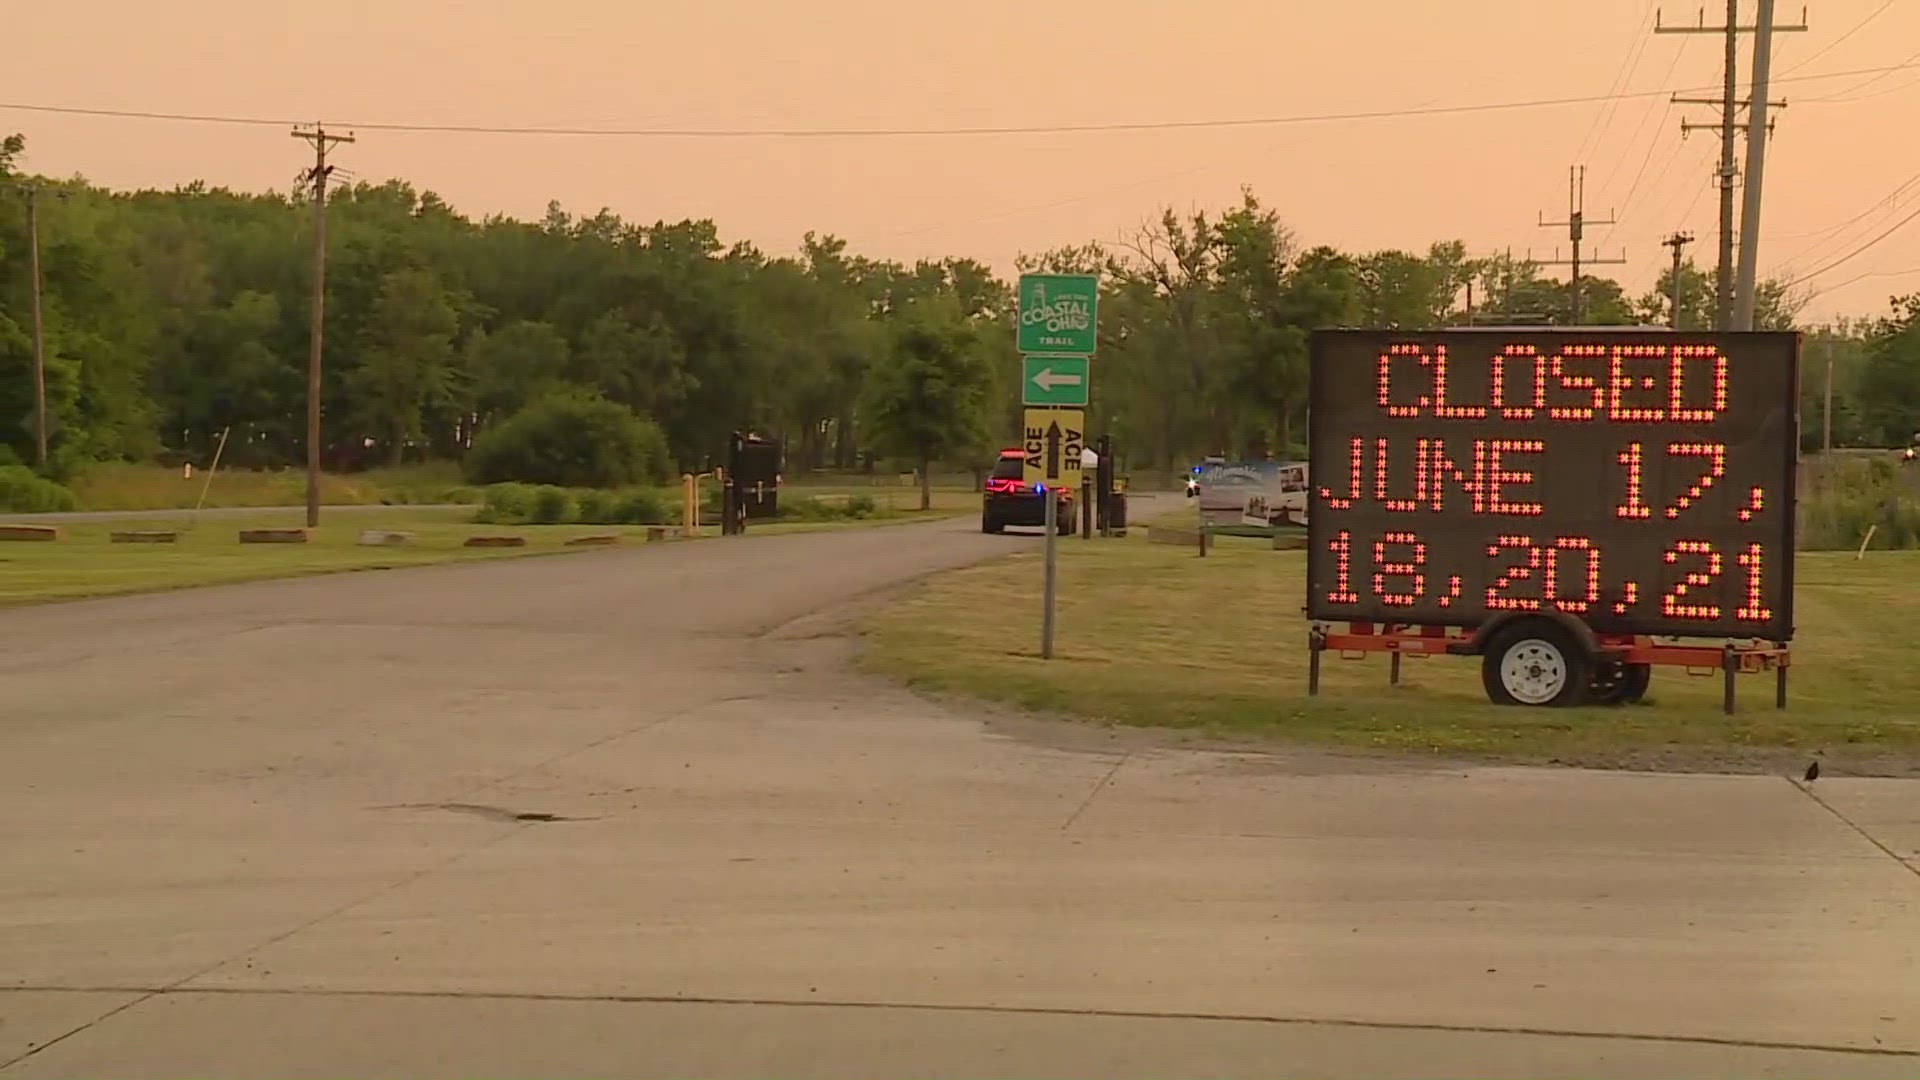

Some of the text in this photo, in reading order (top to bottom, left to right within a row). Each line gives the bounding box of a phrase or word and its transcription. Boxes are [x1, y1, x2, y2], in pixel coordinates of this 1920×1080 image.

[1022, 301, 1089, 325] COASTAL
[1047, 315, 1089, 332] OHIO
[1039, 337, 1075, 346] TRAIL
[1377, 344, 1729, 421] CLOSED
[1026, 427, 1042, 469] ACE
[1065, 428, 1081, 471] ACE
[1320, 437, 1764, 520] JUNE 17,
